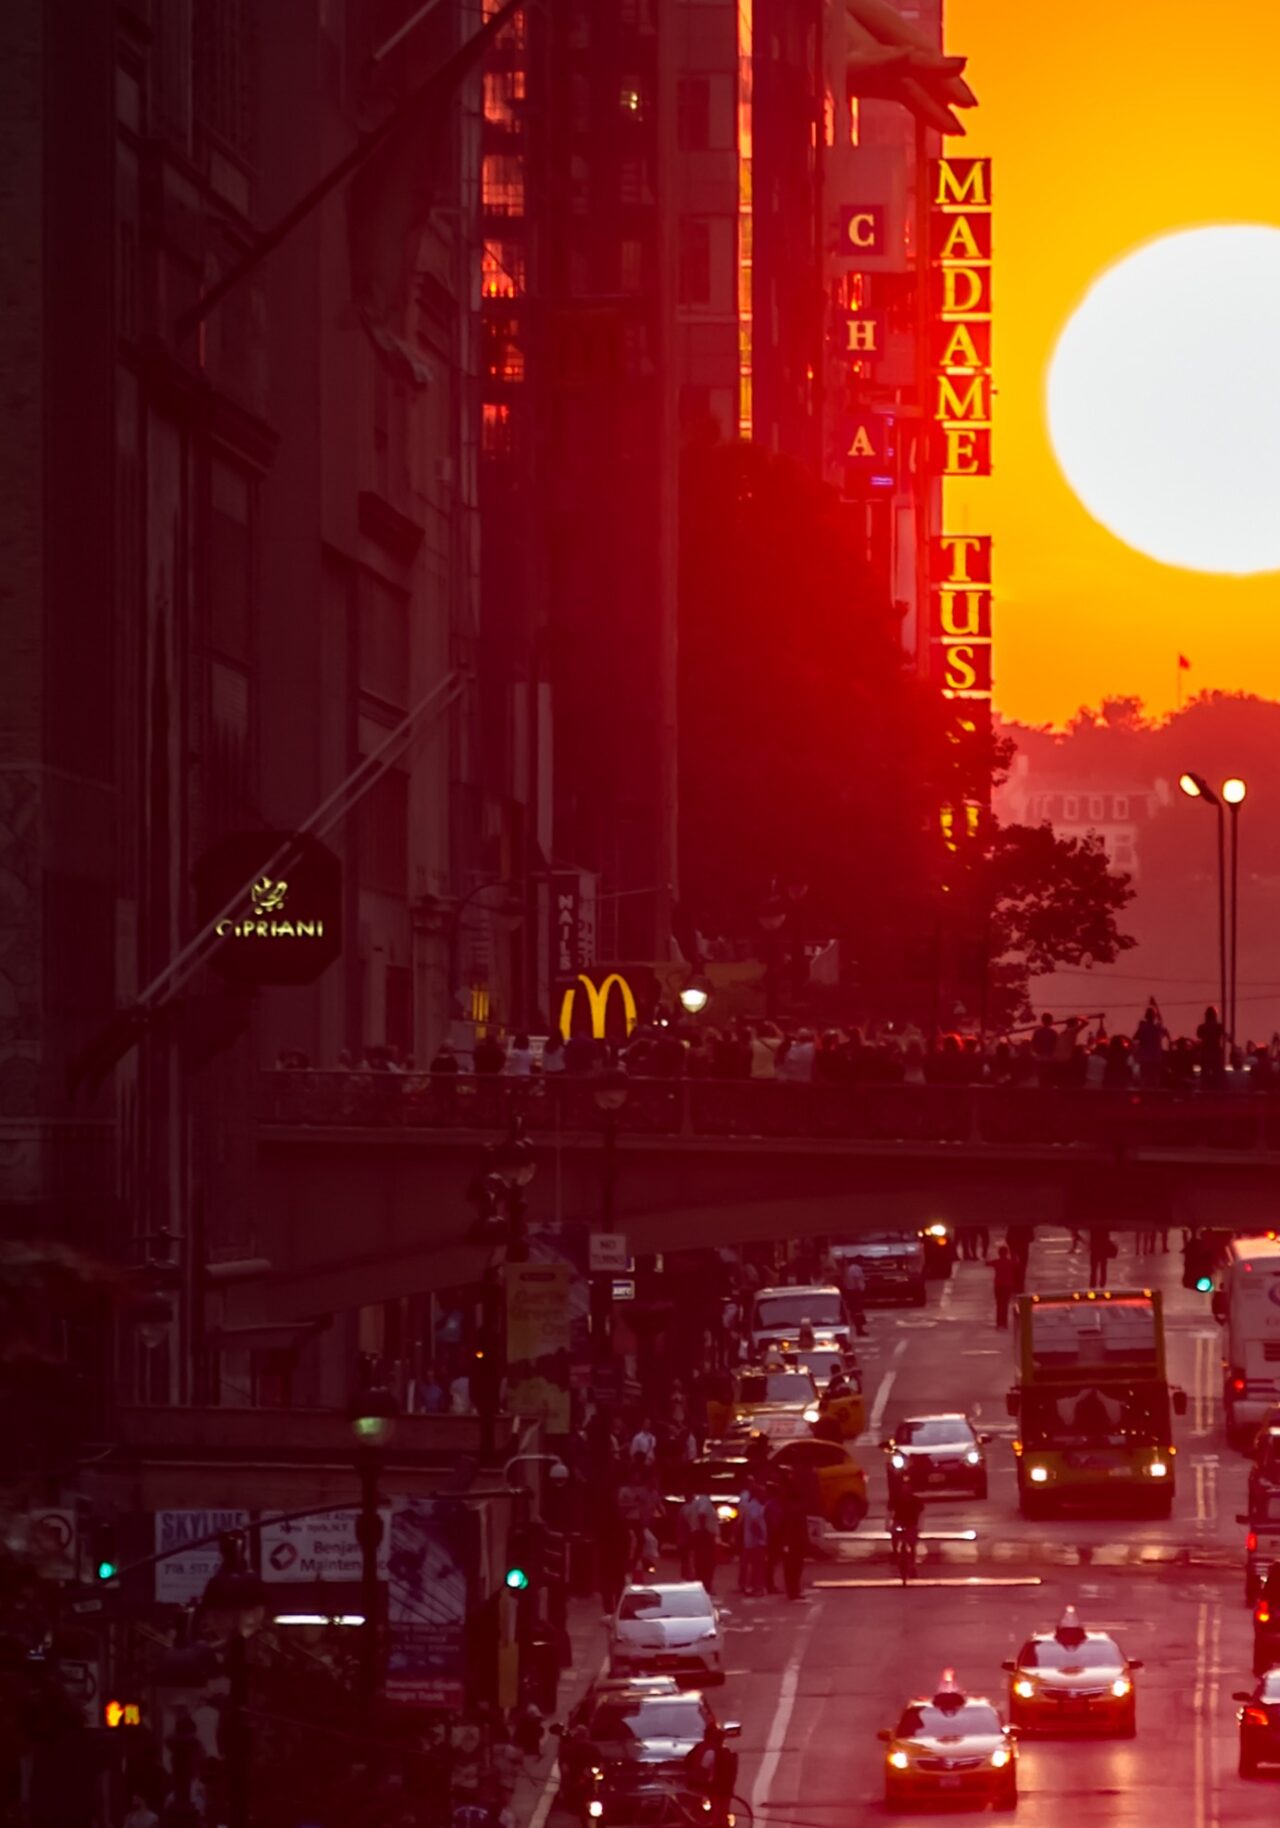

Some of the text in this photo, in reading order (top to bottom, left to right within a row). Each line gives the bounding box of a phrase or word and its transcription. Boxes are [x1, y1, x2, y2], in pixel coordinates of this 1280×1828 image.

[935, 159, 987, 475] MADAME
[939, 537, 984, 740] TUS
[215, 919, 324, 937] CIPRIANI
[557, 893, 574, 971] NAILS
